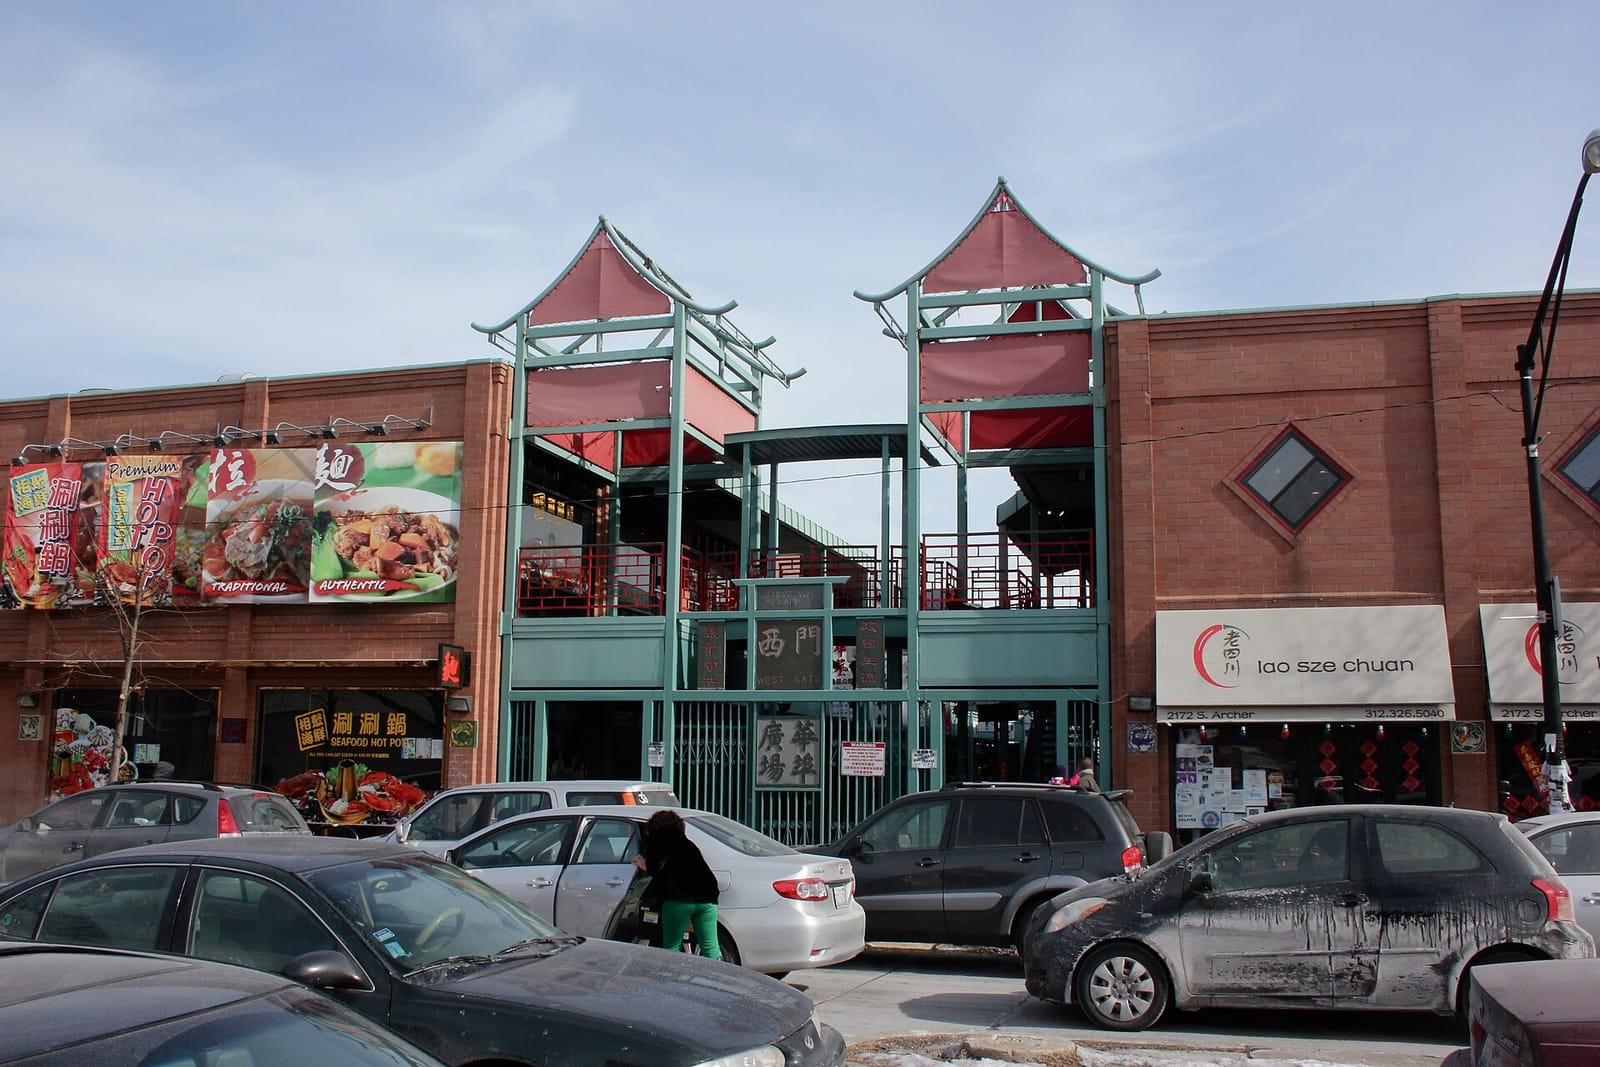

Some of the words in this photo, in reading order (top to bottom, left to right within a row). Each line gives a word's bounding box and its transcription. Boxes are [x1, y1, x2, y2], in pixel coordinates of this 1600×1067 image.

[109, 459, 179, 479] Premium
[211, 581, 289, 593] TRADITIONAL
[319, 580, 387, 591] AUTHENTIC
[758, 625, 821, 658] 西門
[1223, 629, 1241, 677] 老四川
[1257, 659, 1290, 674] lao
[1296, 659, 1337, 673] sze
[1343, 657, 1415, 673] chuan
[758, 675, 785, 686] WEST
[795, 673, 821, 684] GATE
[1166, 711, 1194, 720] 2172
[1196, 711, 1209, 719] S.
[1211, 709, 1256, 719] Archer
[1364, 709, 1446, 719] 312.326.5040
[1501, 709, 1531, 718] 2172
[1561, 709, 1598, 718] rcher
[332, 712, 407, 736] 涮涮鍋
[330, 737, 368, 748] SEAFOOD
[370, 737, 387, 748] HOT
[389, 737, 406, 748] POT
